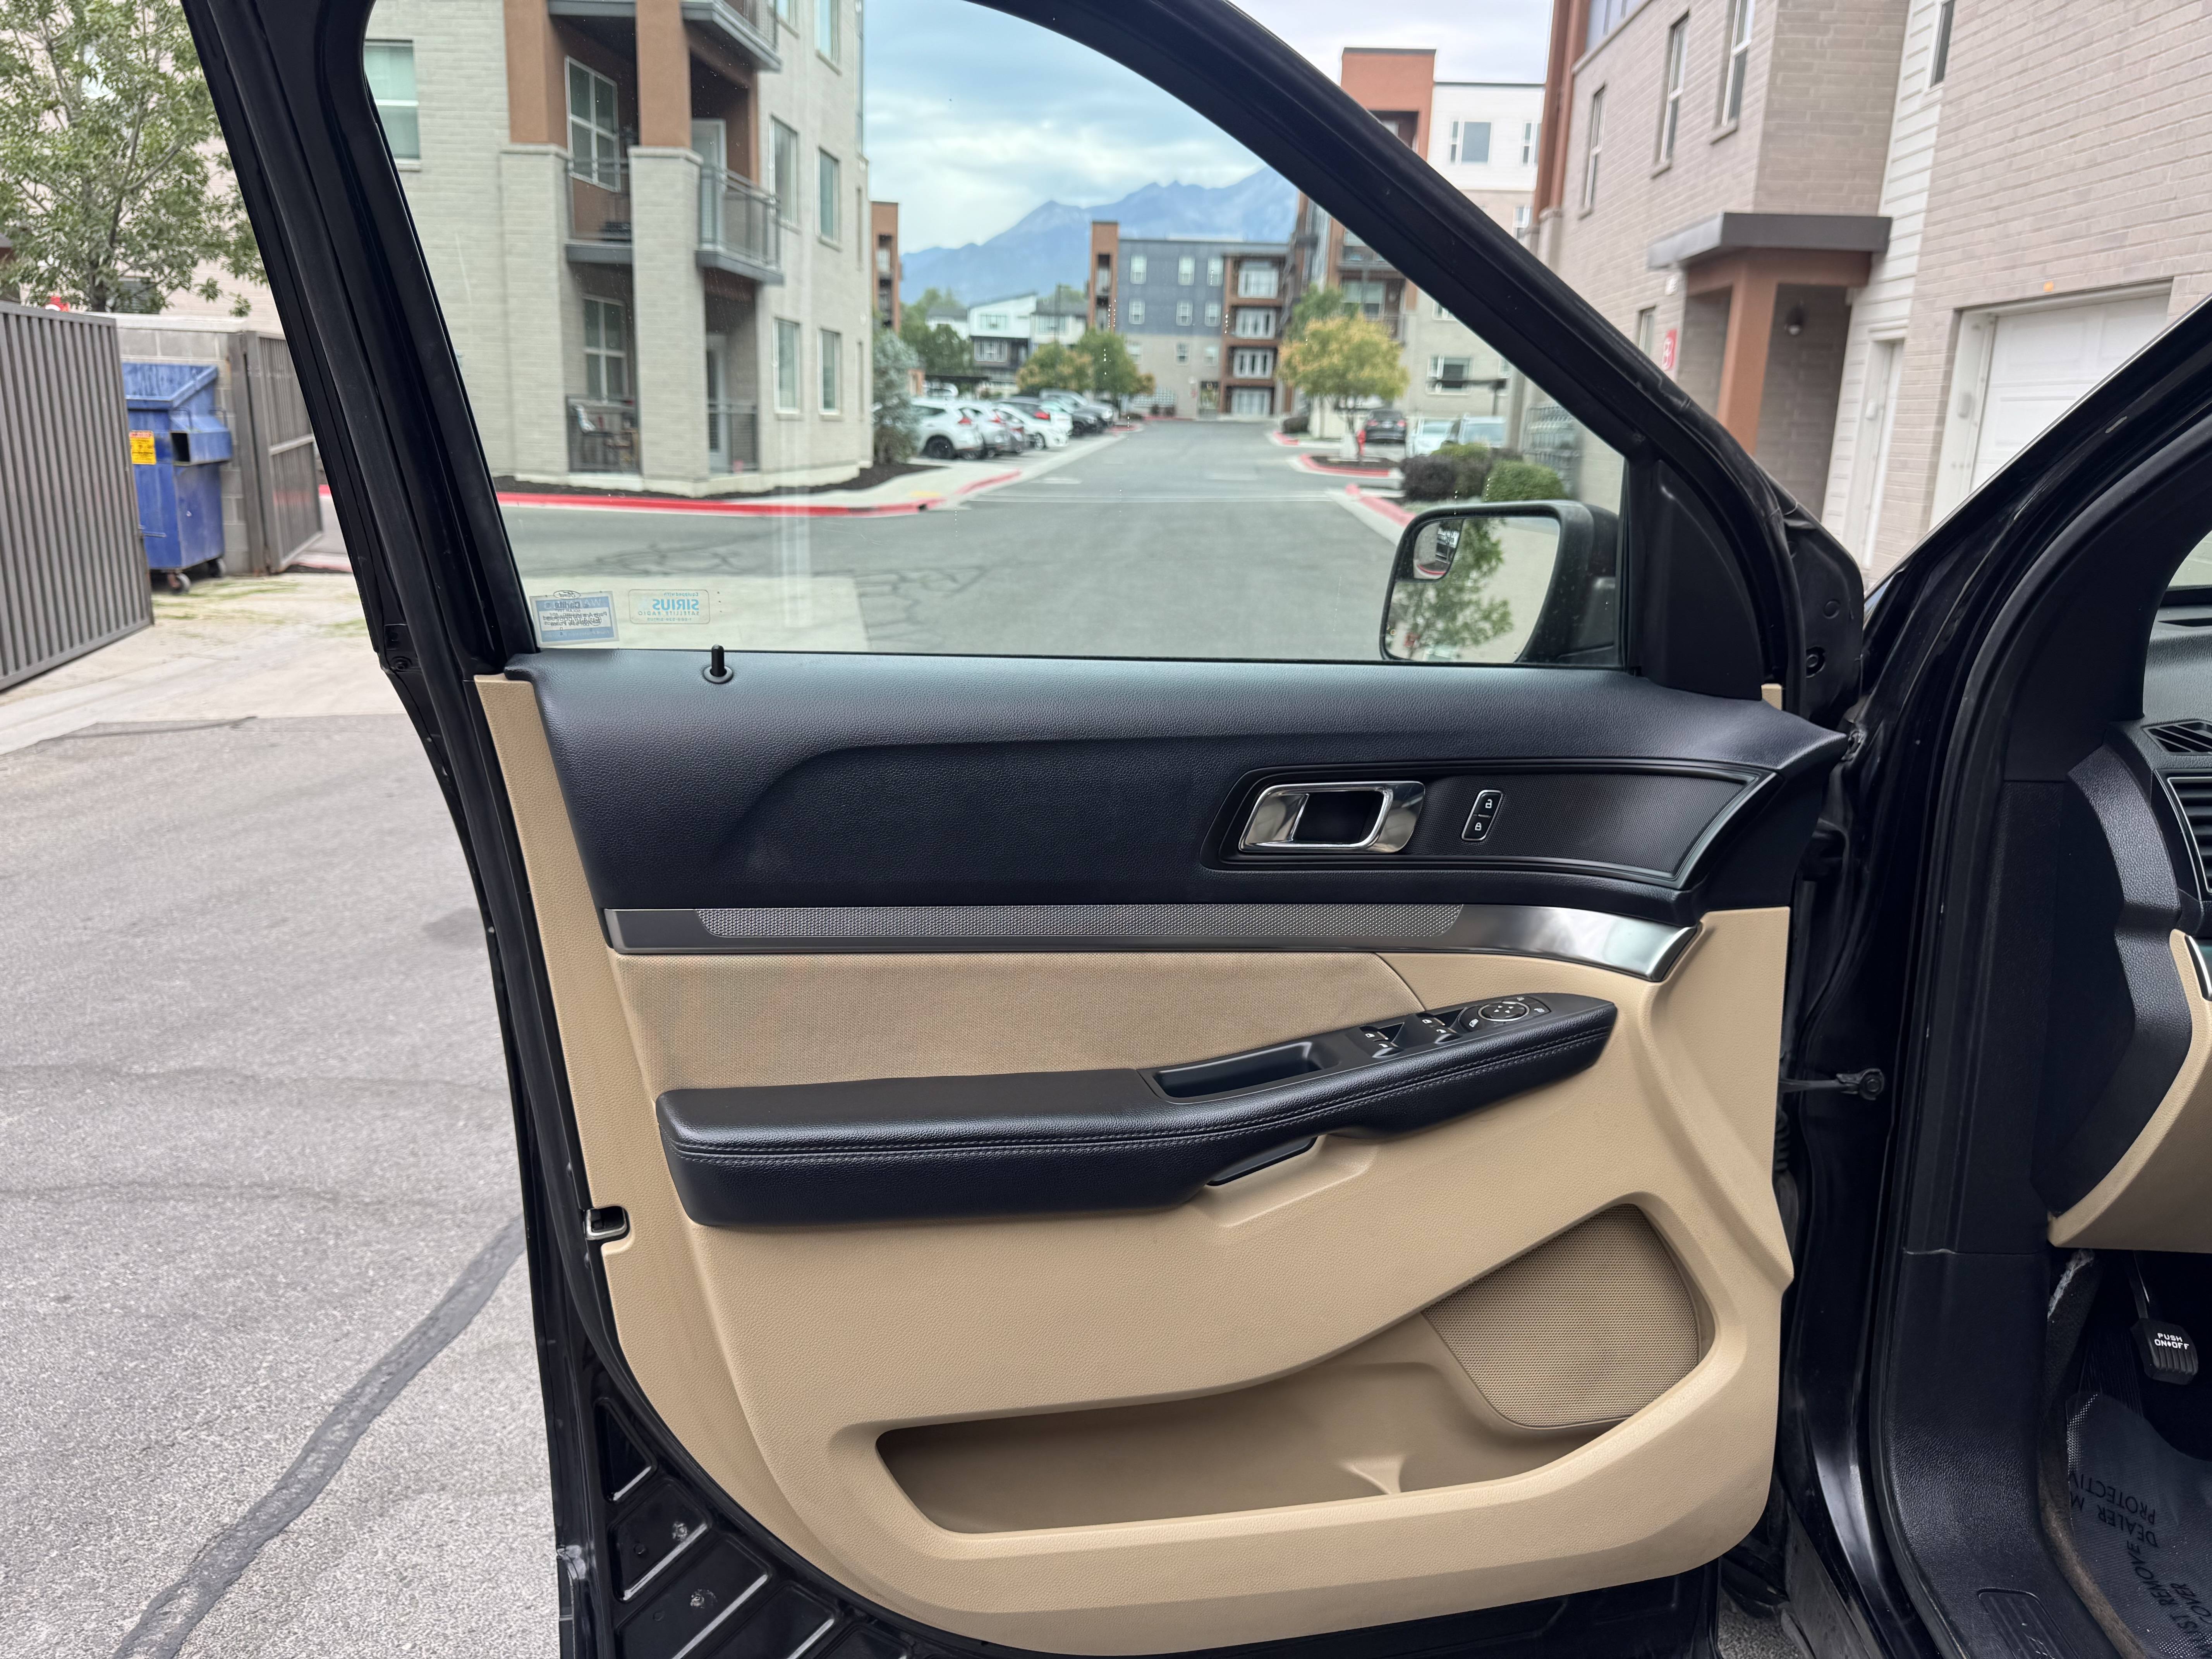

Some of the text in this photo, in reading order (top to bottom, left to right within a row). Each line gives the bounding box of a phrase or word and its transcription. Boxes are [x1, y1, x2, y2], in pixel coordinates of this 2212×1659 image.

[2157, 1333, 2183, 1342] PUSH
[2097, 1504, 2159, 1548] DEALER
[2126, 1540, 2179, 1606] REMOVE
